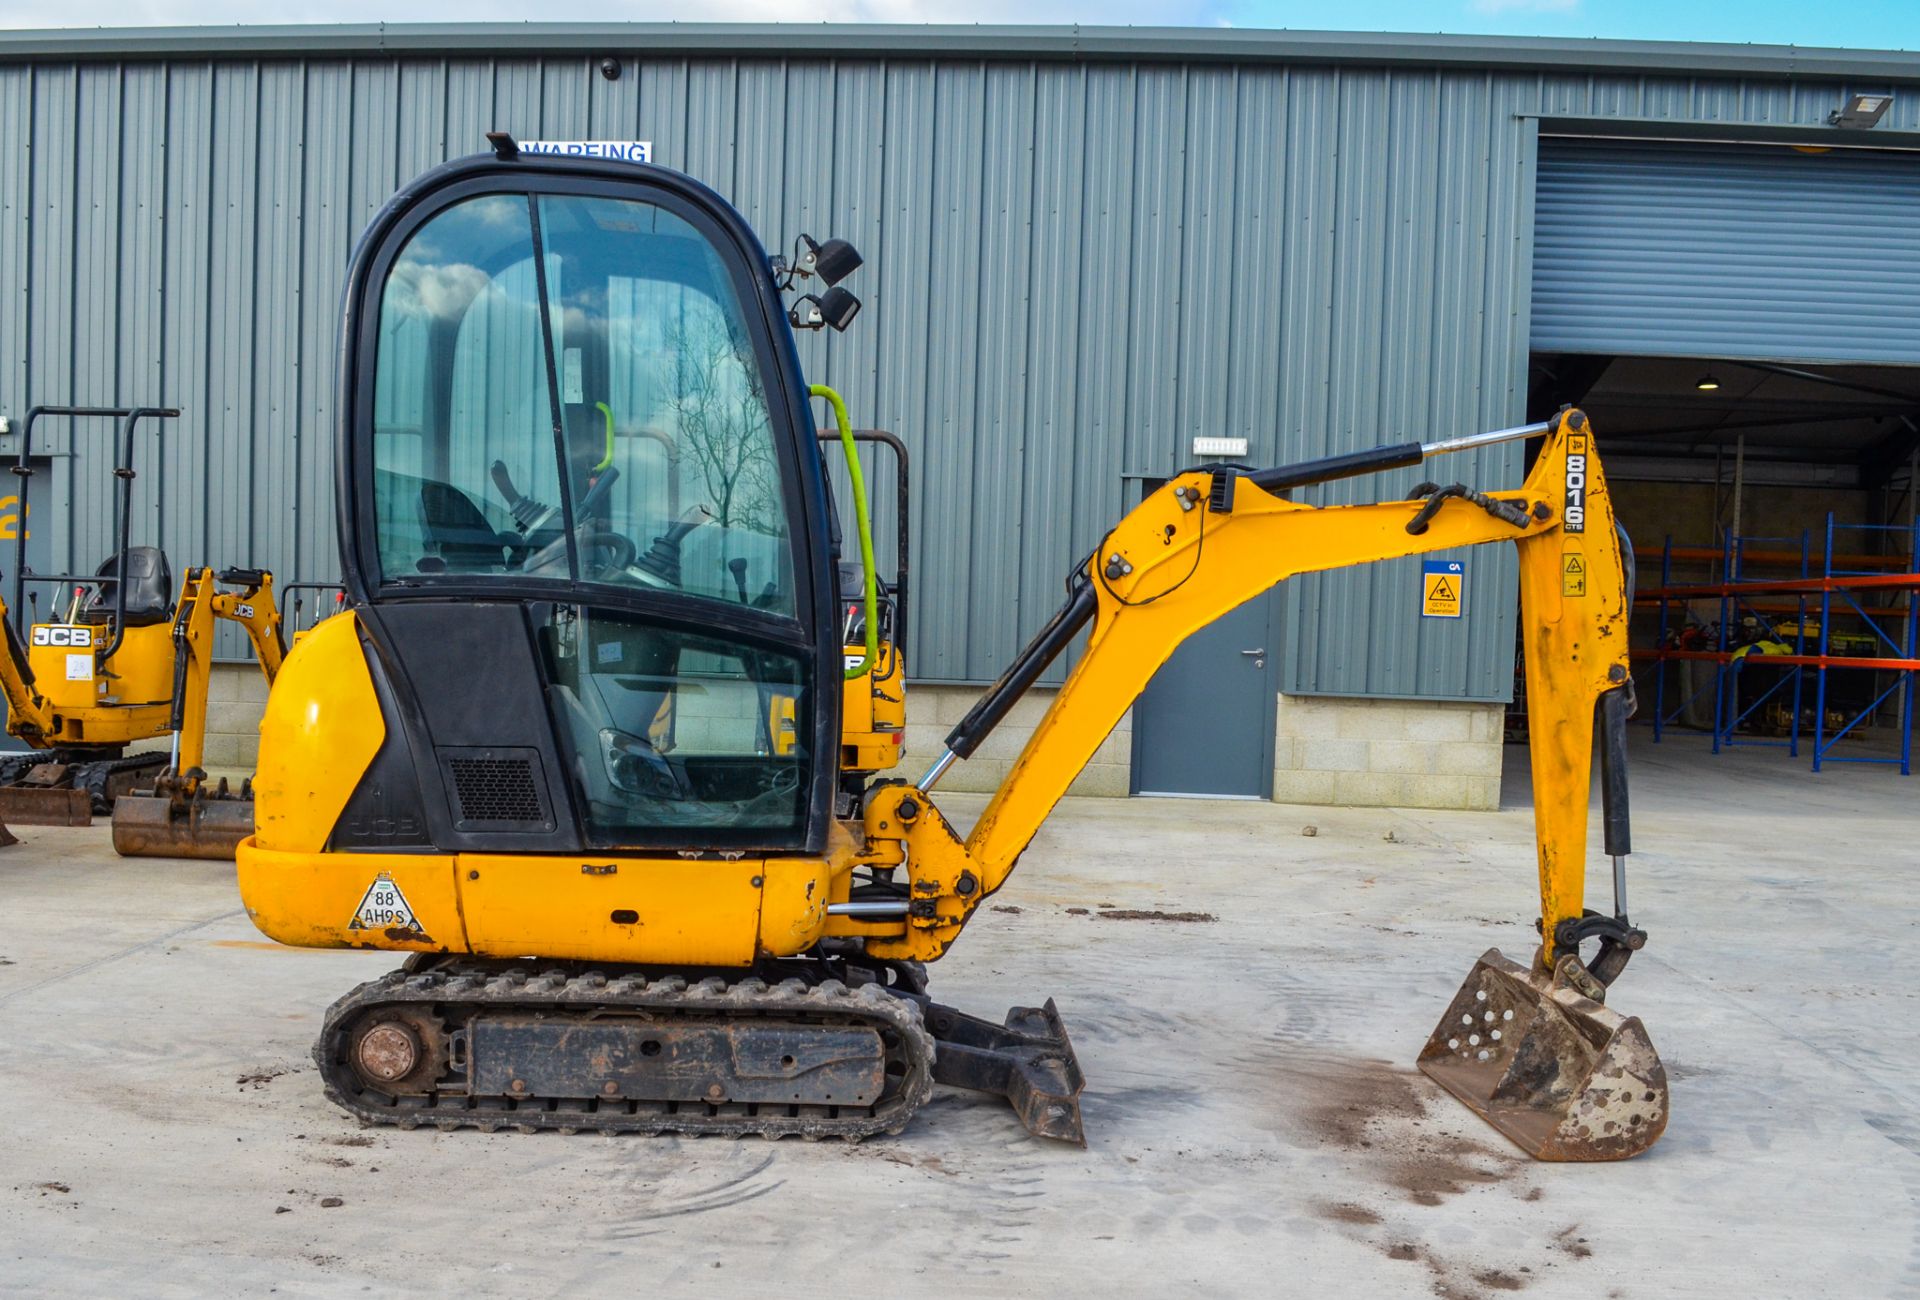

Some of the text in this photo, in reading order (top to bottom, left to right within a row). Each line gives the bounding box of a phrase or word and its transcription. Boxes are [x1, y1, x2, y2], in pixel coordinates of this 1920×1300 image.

[1565, 455, 1585, 524] 8016
[234, 604, 254, 618] JCB
[33, 627, 91, 647] JCB
[375, 891, 394, 906] 88
